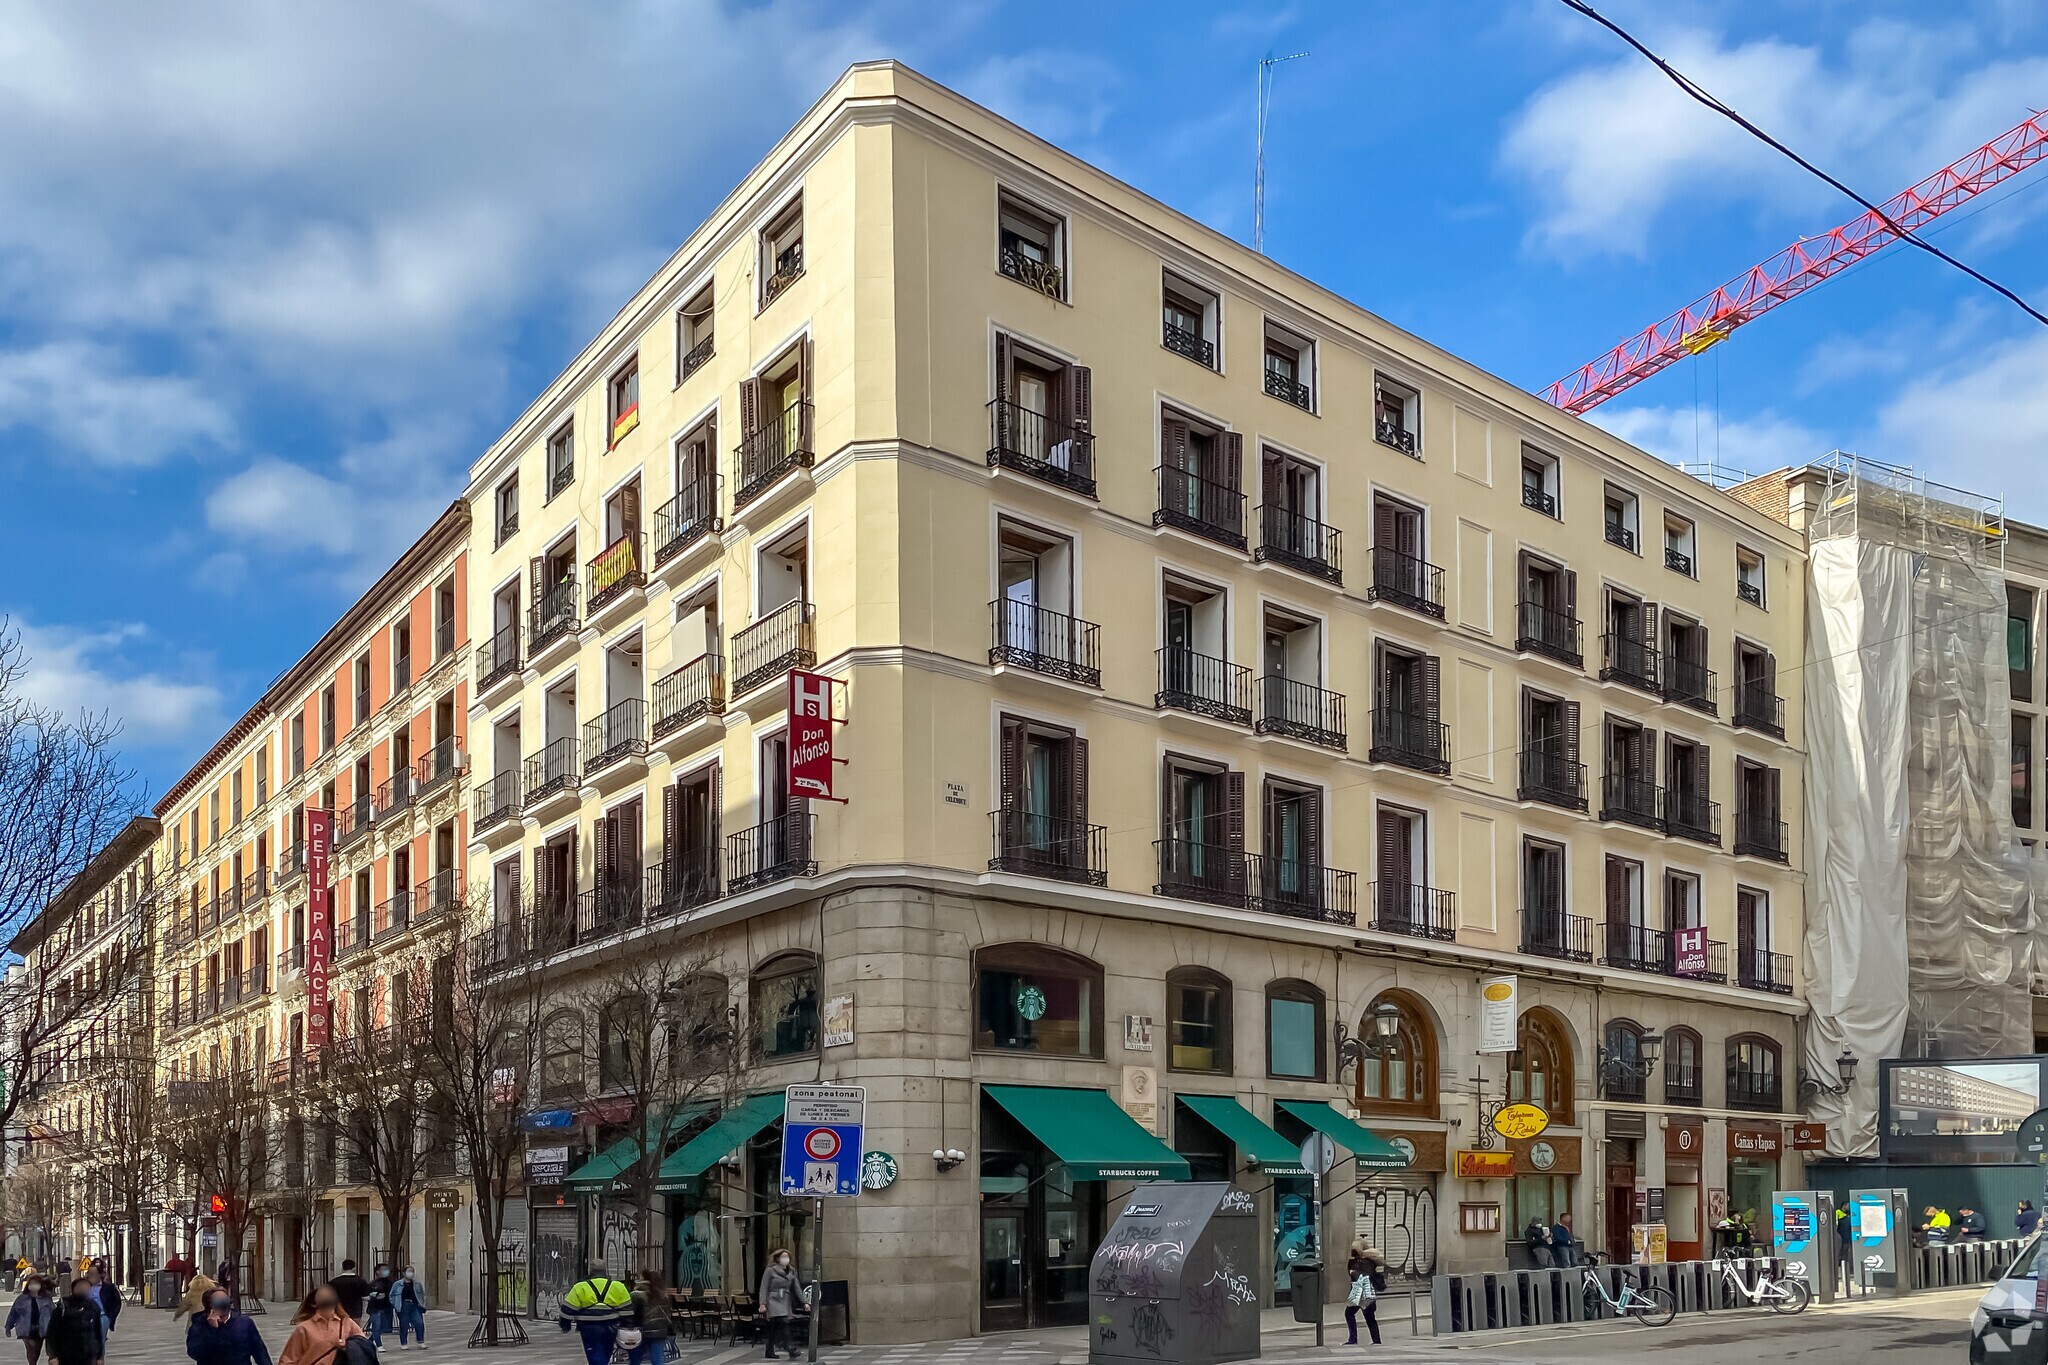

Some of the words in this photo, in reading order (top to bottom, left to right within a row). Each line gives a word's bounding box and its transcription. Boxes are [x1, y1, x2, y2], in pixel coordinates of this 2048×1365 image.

[802, 728, 824, 742] Don
[792, 740, 830, 768] Alfonso
[312, 823, 324, 902] PETIT
[312, 911, 325, 1007] PALACE
[1688, 953, 1704, 961] Don
[1677, 959, 1706, 971] Alfonso
[794, 1089, 815, 1097] zona
[818, 1090, 858, 1098] peatonal
[1734, 1132, 1754, 1149] Cañas
[1757, 1134, 1776, 1153] Tapas
[1136, 1169, 1160, 1177] COFFEE
